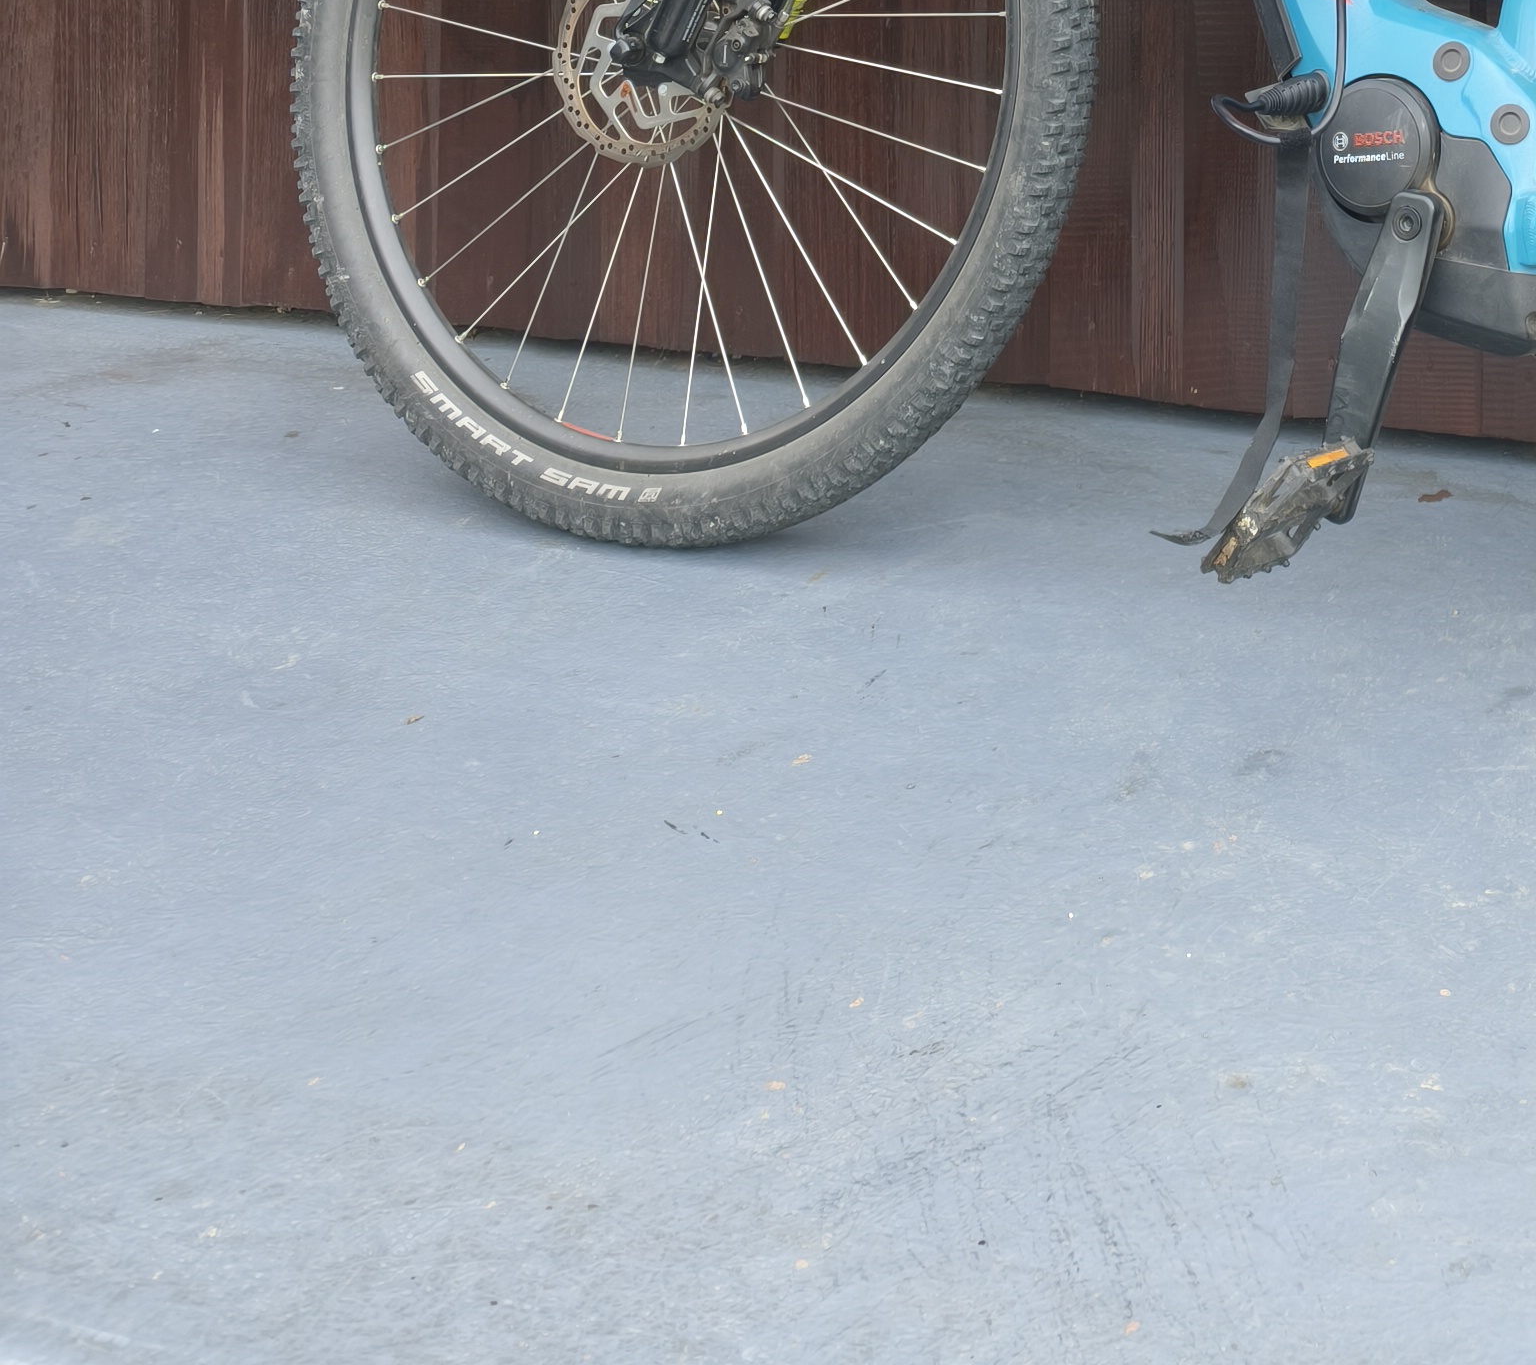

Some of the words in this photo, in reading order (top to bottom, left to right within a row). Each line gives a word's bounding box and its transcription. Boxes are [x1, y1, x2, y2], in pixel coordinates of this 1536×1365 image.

[1353, 129, 1405, 148] BOSCH
[1333, 150, 1405, 165] PerformanceLine
[410, 370, 534, 467] SMART
[539, 467, 633, 502] SAM
